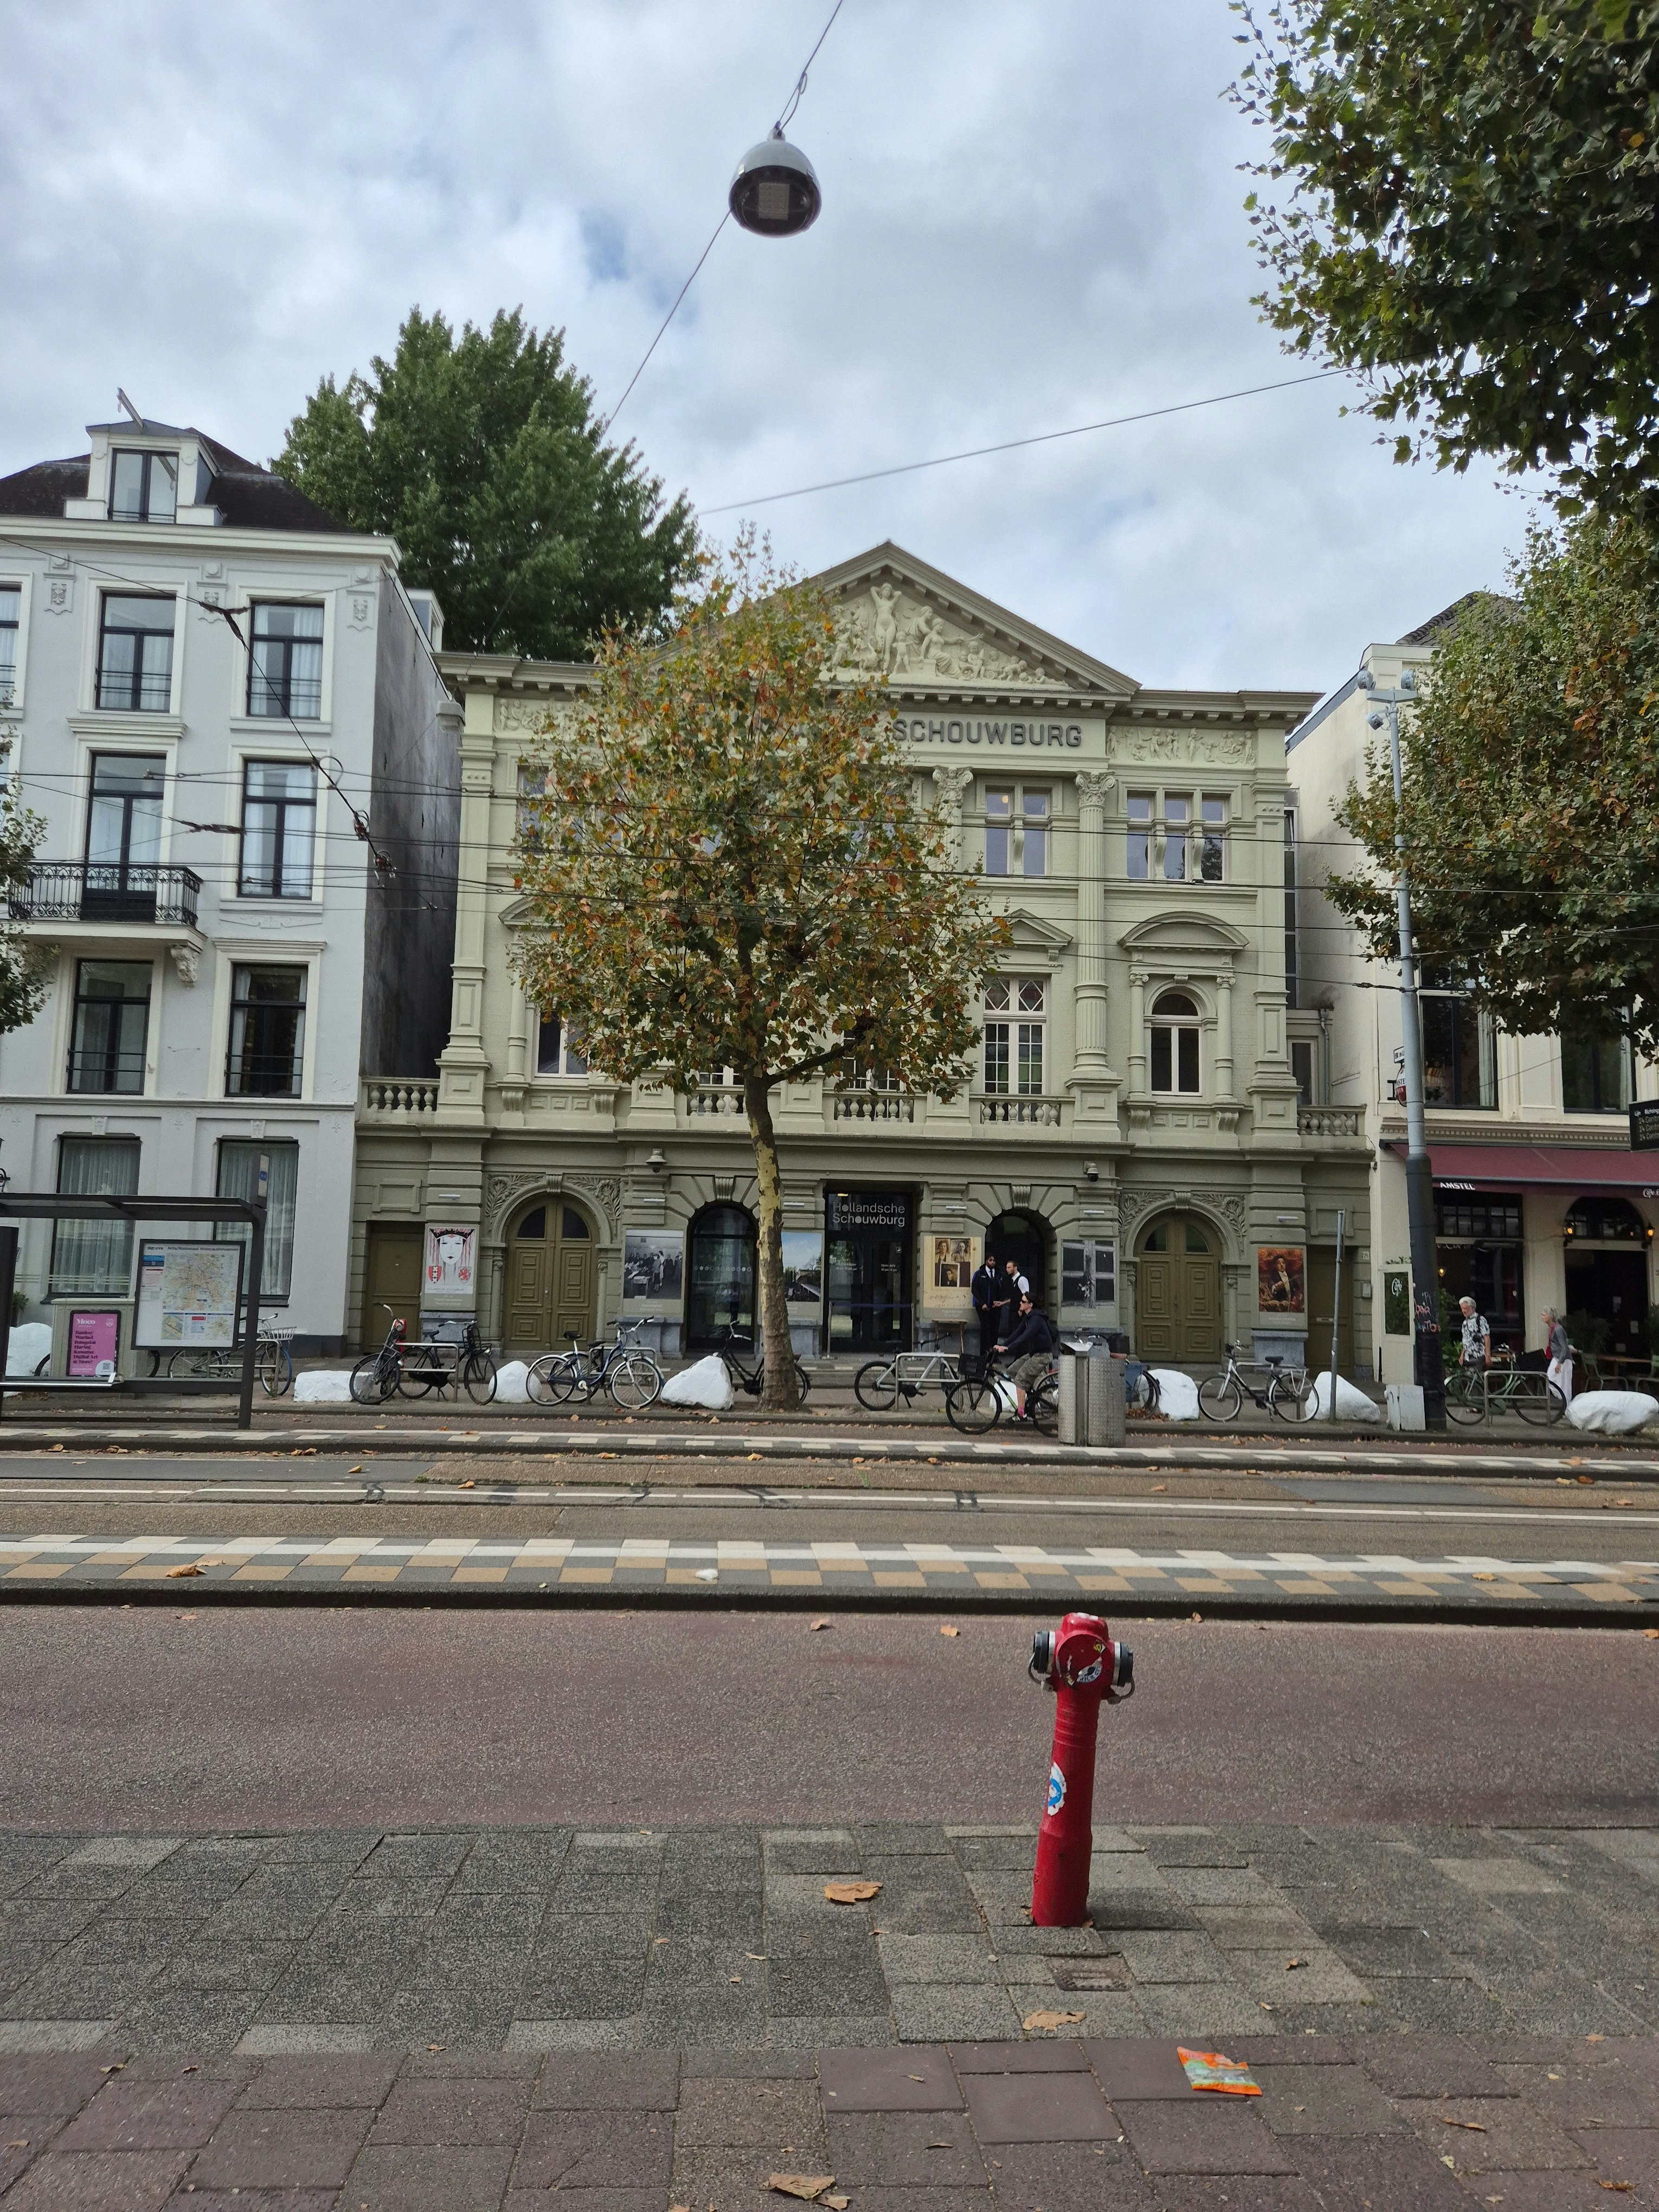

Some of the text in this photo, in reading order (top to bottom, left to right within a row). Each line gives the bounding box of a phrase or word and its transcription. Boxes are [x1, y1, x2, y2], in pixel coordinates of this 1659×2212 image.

[892, 718, 1082, 747] SCHOUWBURG
[1440, 1181, 1476, 1191] AMSTEL
[833, 1203, 905, 1214] Hollandsche
[833, 1213, 905, 1227] Schouwburg
